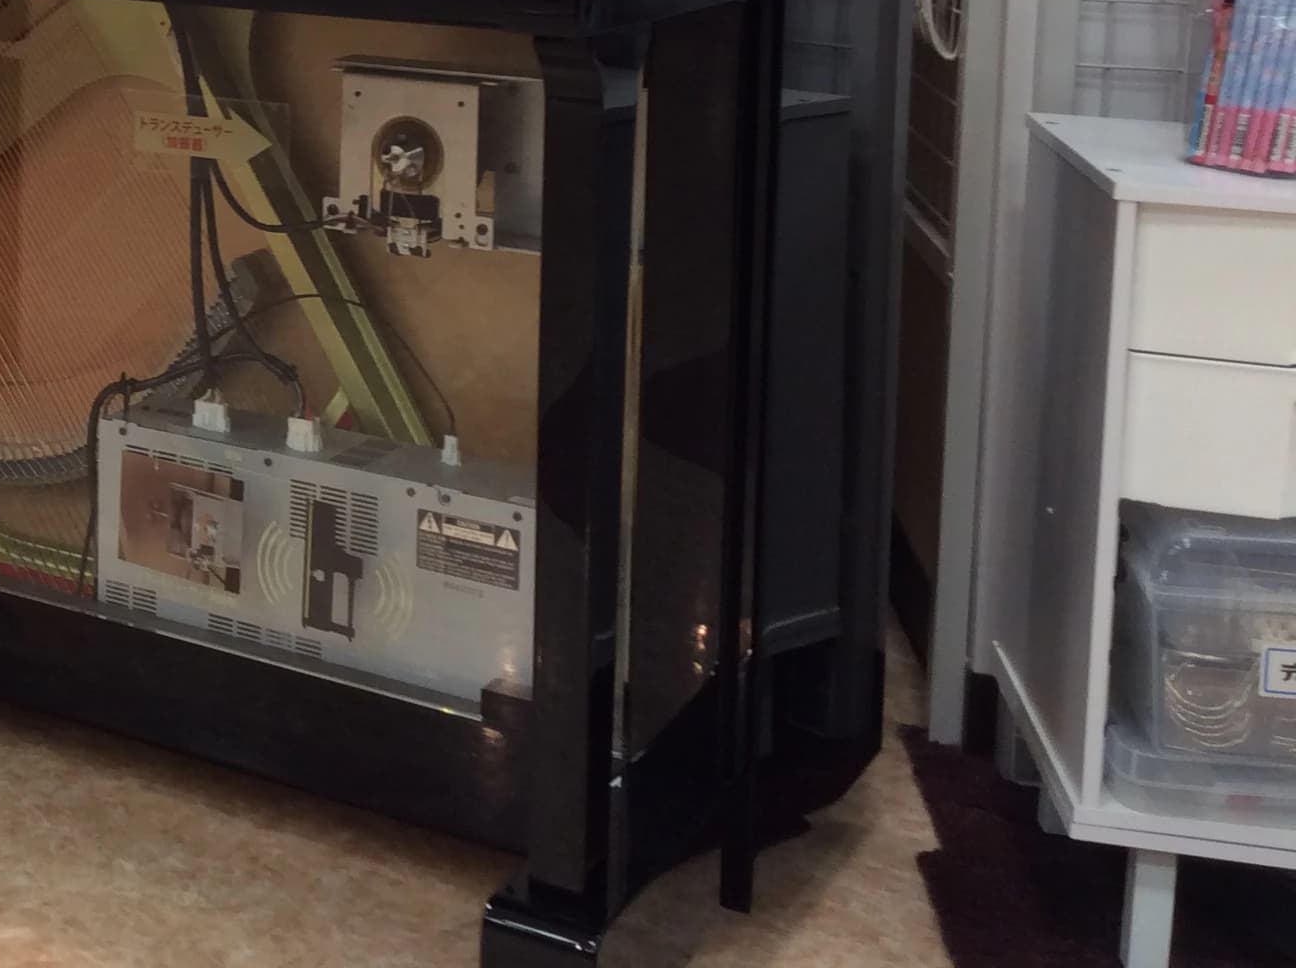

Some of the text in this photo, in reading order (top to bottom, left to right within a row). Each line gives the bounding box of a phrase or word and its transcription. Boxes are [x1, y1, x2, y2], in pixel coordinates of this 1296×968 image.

[140, 116, 233, 138] トランスデューサー
